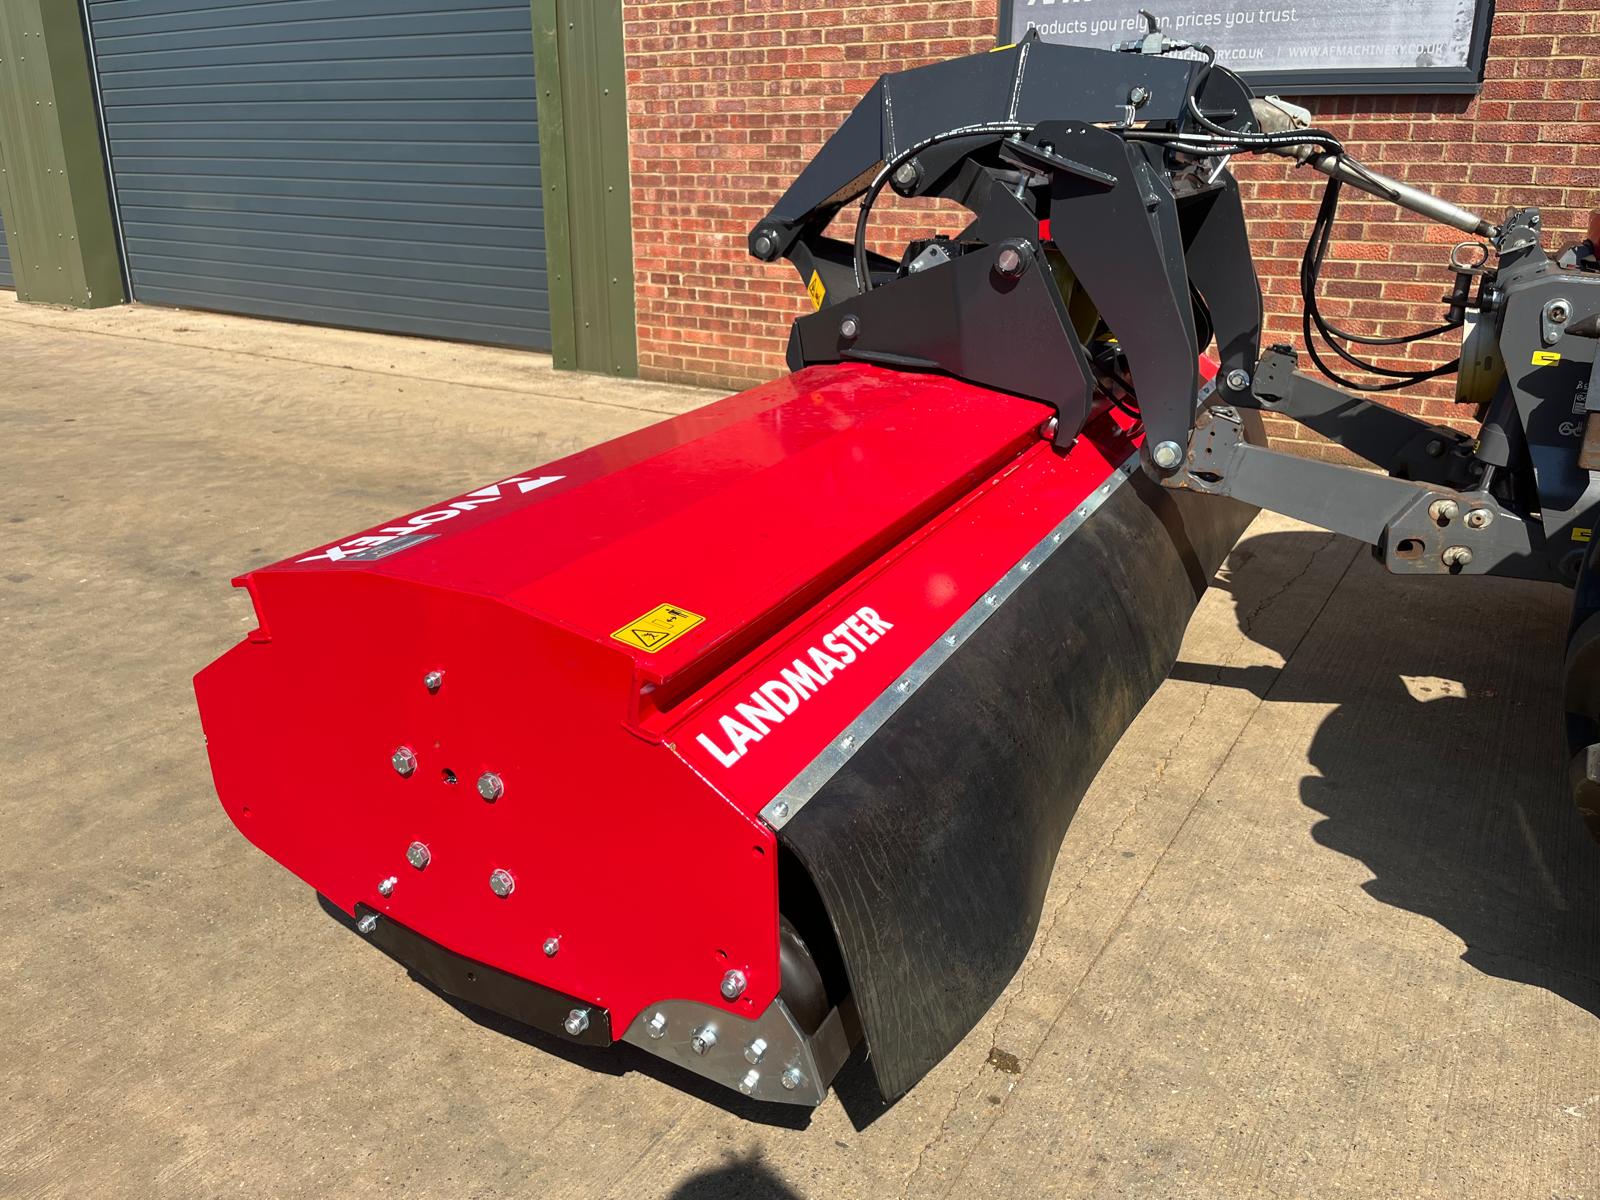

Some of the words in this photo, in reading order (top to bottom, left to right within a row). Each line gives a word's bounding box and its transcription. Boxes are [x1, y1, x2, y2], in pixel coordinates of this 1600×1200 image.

[1026, 19, 1087, 35] Products
[1091, 19, 1117, 35] you
[1120, 15, 1149, 32] rely
[1175, 11, 1222, 30] prices
[1225, 10, 1255, 28] you
[1258, 7, 1299, 23] trust.
[1288, 44, 1444, 58] WWW.AFMACHINERY.CO.UK
[695, 606, 895, 769] LANDMASTER
